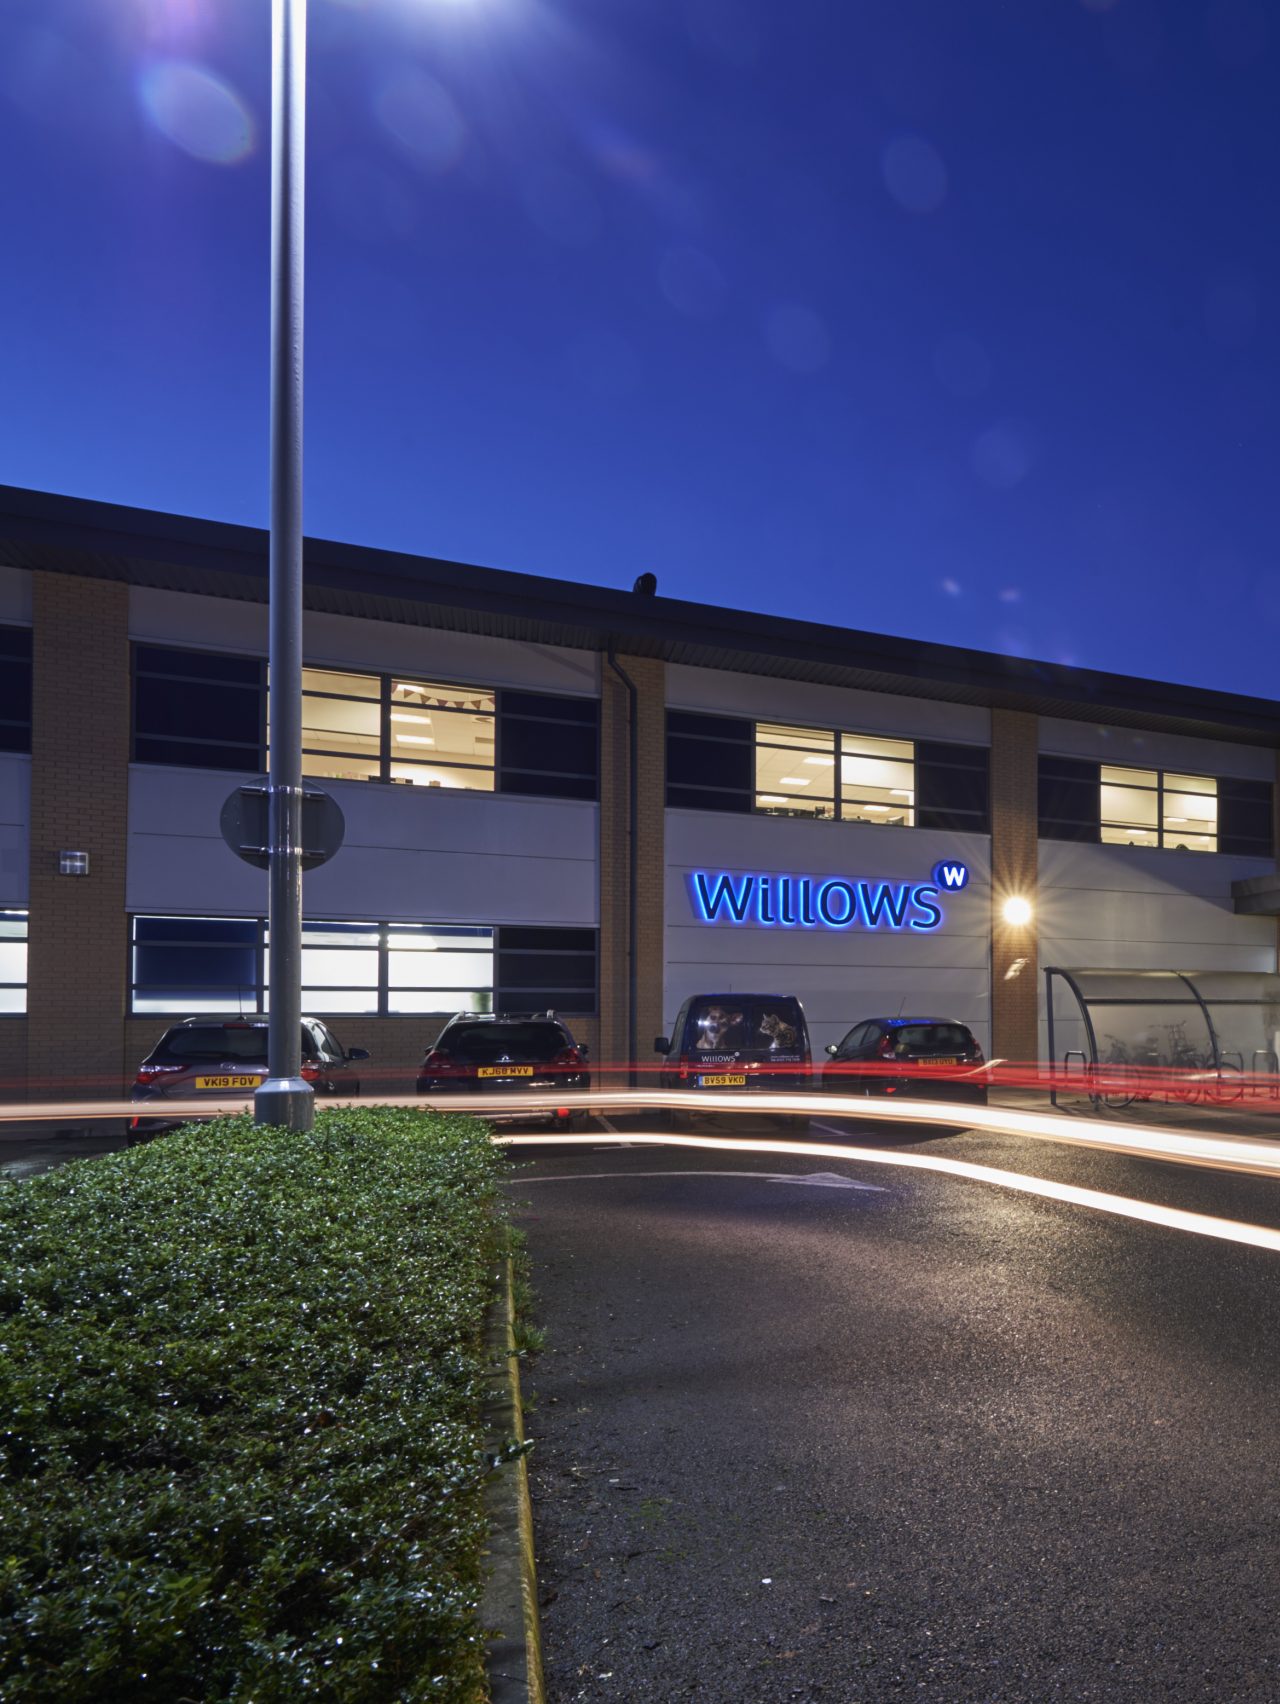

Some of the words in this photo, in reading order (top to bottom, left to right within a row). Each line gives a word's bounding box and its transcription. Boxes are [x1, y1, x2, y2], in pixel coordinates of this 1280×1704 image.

[943, 866, 965, 886] W
[204, 1077, 229, 1086] VK19
[232, 1077, 255, 1086] FOV
[704, 1076, 726, 1084] BV59
